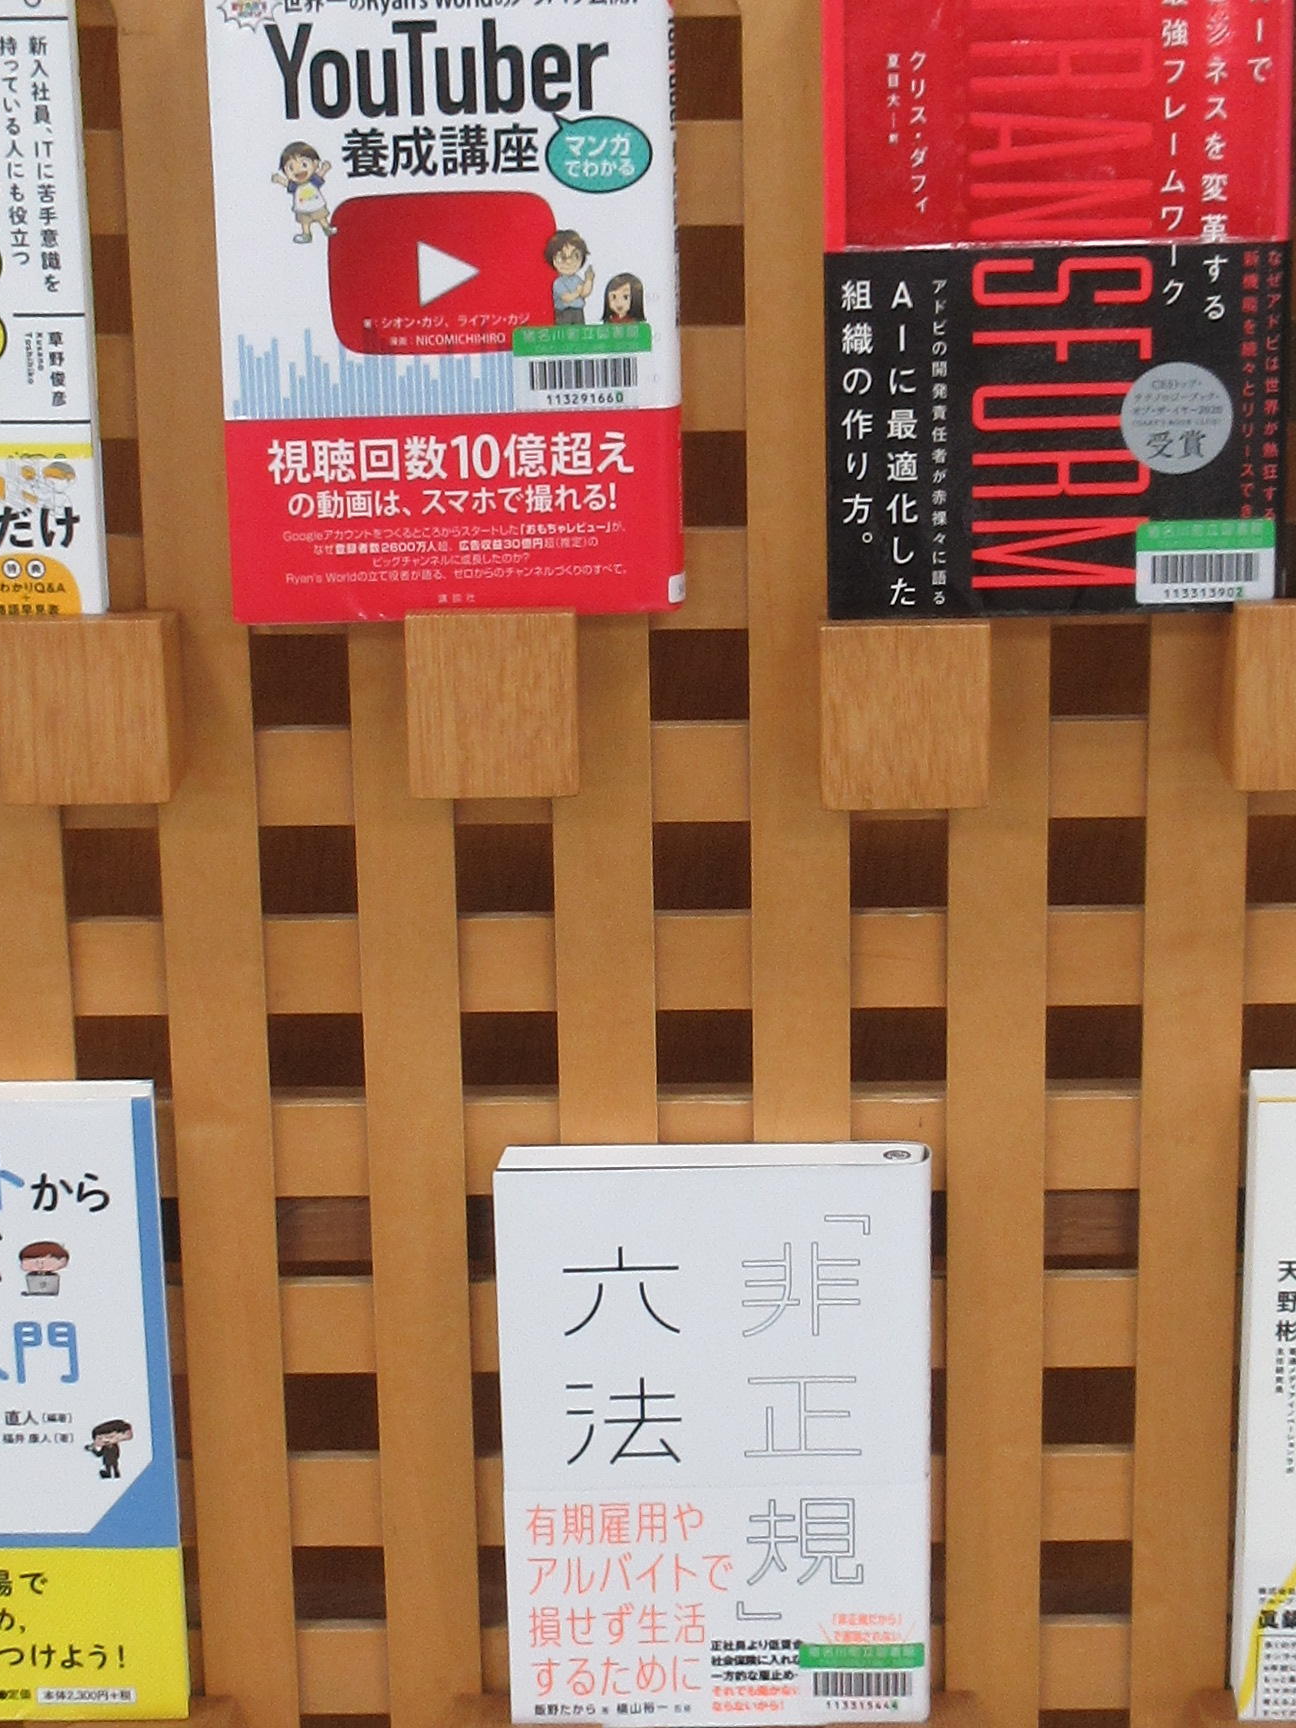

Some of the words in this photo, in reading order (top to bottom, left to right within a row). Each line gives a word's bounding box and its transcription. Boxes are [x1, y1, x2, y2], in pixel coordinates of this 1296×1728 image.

[264, 17, 609, 120] YouTuber
[341, 124, 541, 178] 養成講座
[564, 135, 633, 157] マンガ
[909, 50, 929, 214] クリス・ダフィ
[564, 157, 636, 178] でわかる
[546, 391, 624, 406] 113291660
[840, 279, 874, 546] 組織の作り方。
[268, 430, 635, 484] 視聴回数10億超え
[886, 280, 919, 607] AIに最適化した
[1146, 429, 1207, 460] 受賞
[288, 483, 618, 520] の動画は、スマホで撮れる!
[1163, 585, 1245, 600] 113313902
[562, 1246, 682, 1465] 六法
[525, 1501, 704, 1546] 有期雇用や
[527, 1552, 733, 1596] アルバイトで
[528, 1603, 705, 1649] 損せず生活
[532, 1654, 703, 1698] するために
